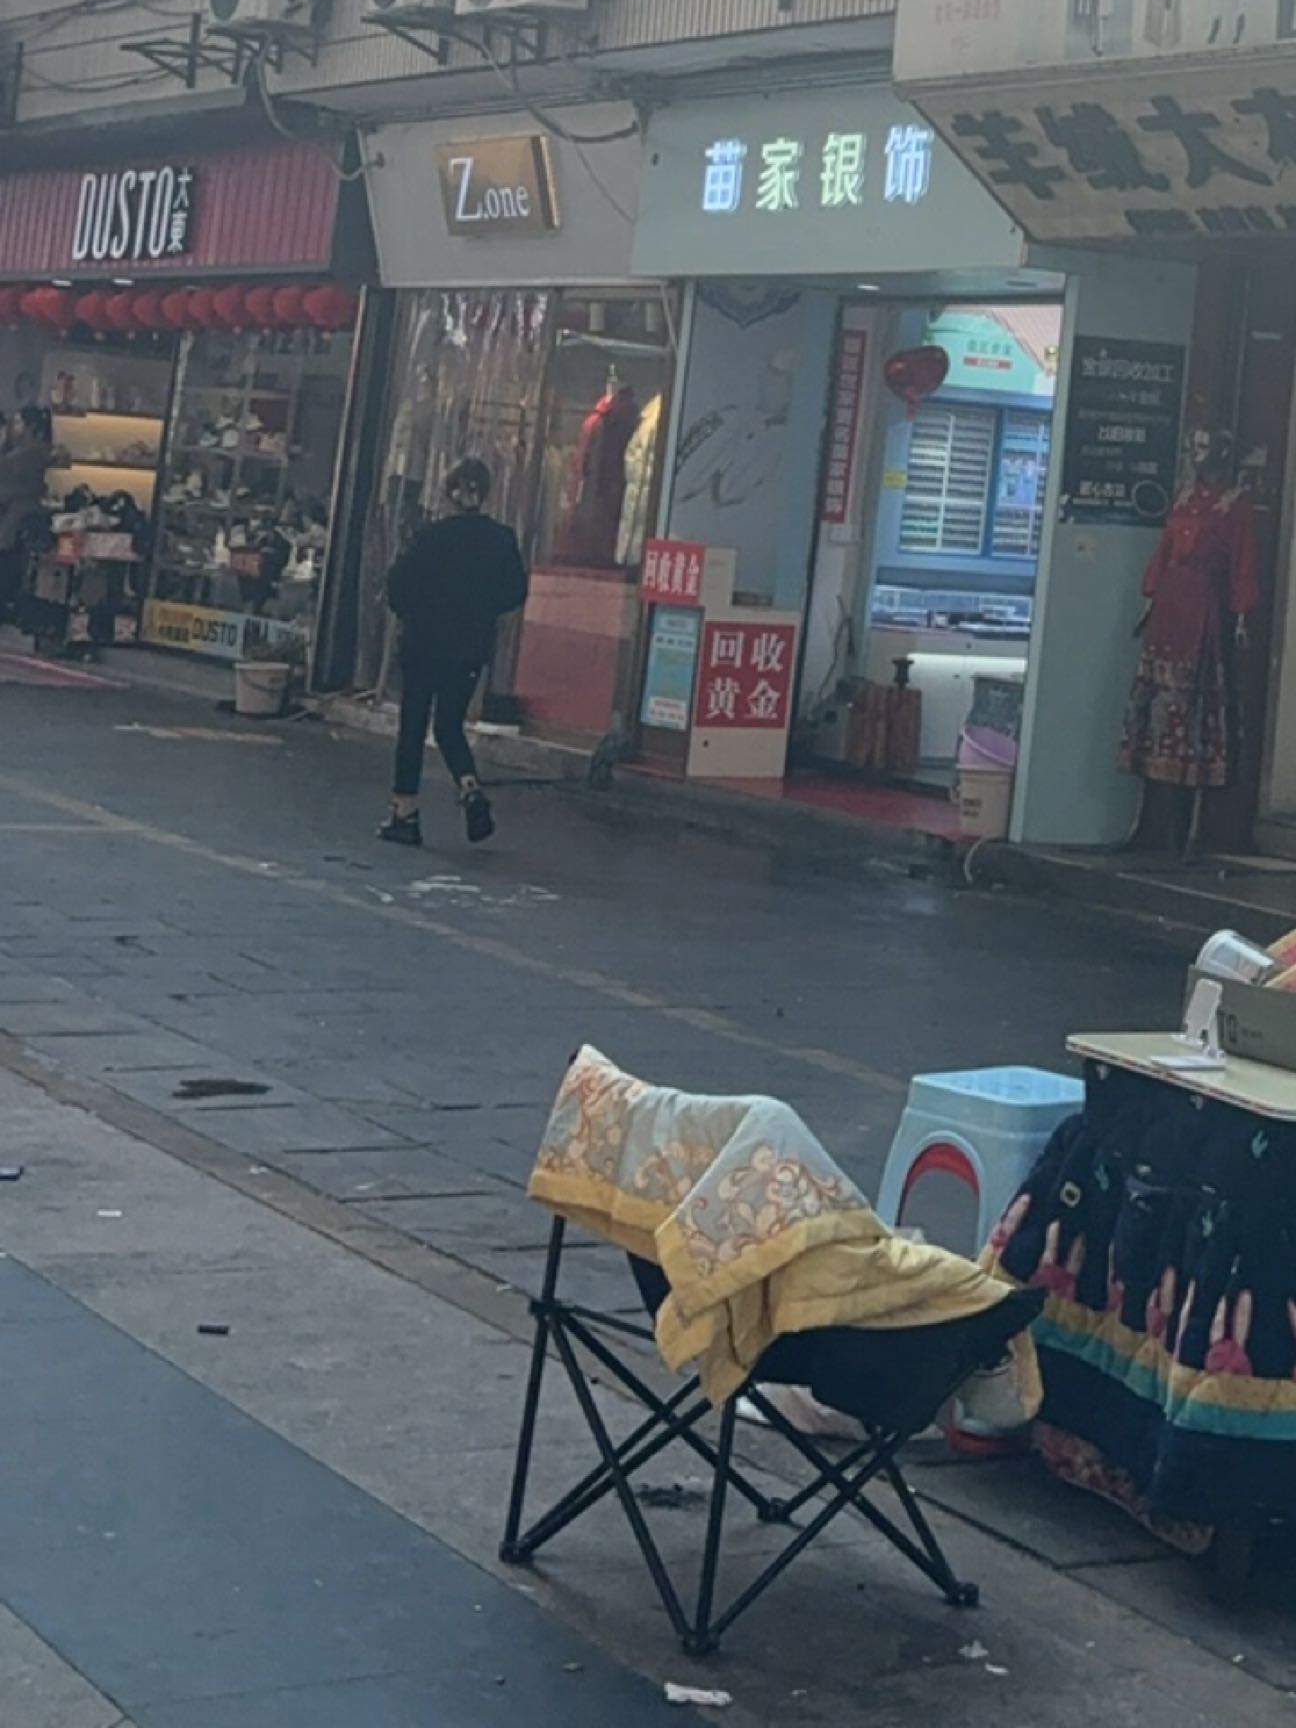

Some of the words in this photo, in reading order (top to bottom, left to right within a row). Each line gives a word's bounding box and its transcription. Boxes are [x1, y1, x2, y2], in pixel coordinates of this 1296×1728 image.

[702, 124, 935, 214] 苗家银饰
[72, 165, 174, 260] DUSTO
[710, 631, 786, 672] 回收
[703, 677, 782, 720] 黄金
